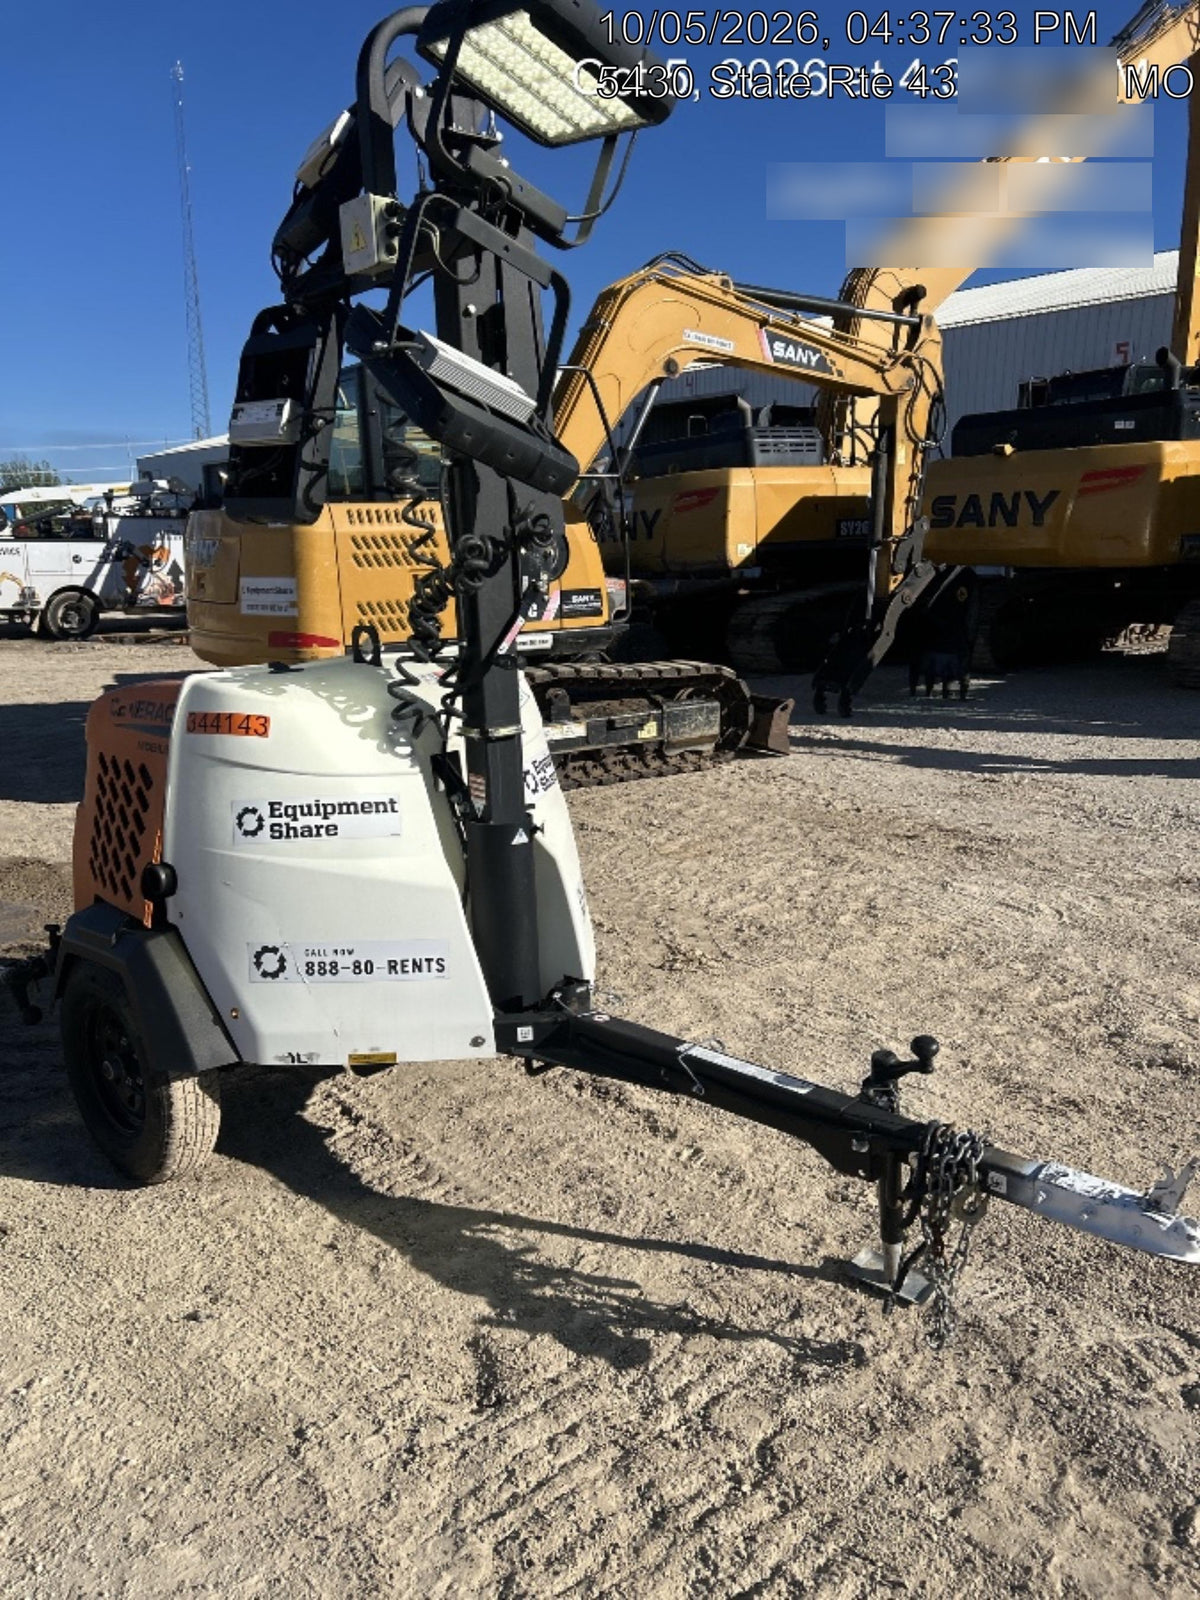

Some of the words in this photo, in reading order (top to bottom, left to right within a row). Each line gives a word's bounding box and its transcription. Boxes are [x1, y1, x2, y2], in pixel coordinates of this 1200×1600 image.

[773, 341, 821, 368] SANY
[930, 490, 1061, 529] SANY
[186, 712, 269, 737] 344143
[268, 797, 400, 822] Equipment
[269, 822, 339, 840] Share
[304, 948, 329, 957] CALL
[332, 948, 355, 956] NOW
[304, 957, 446, 977] 888-80-RENTS
